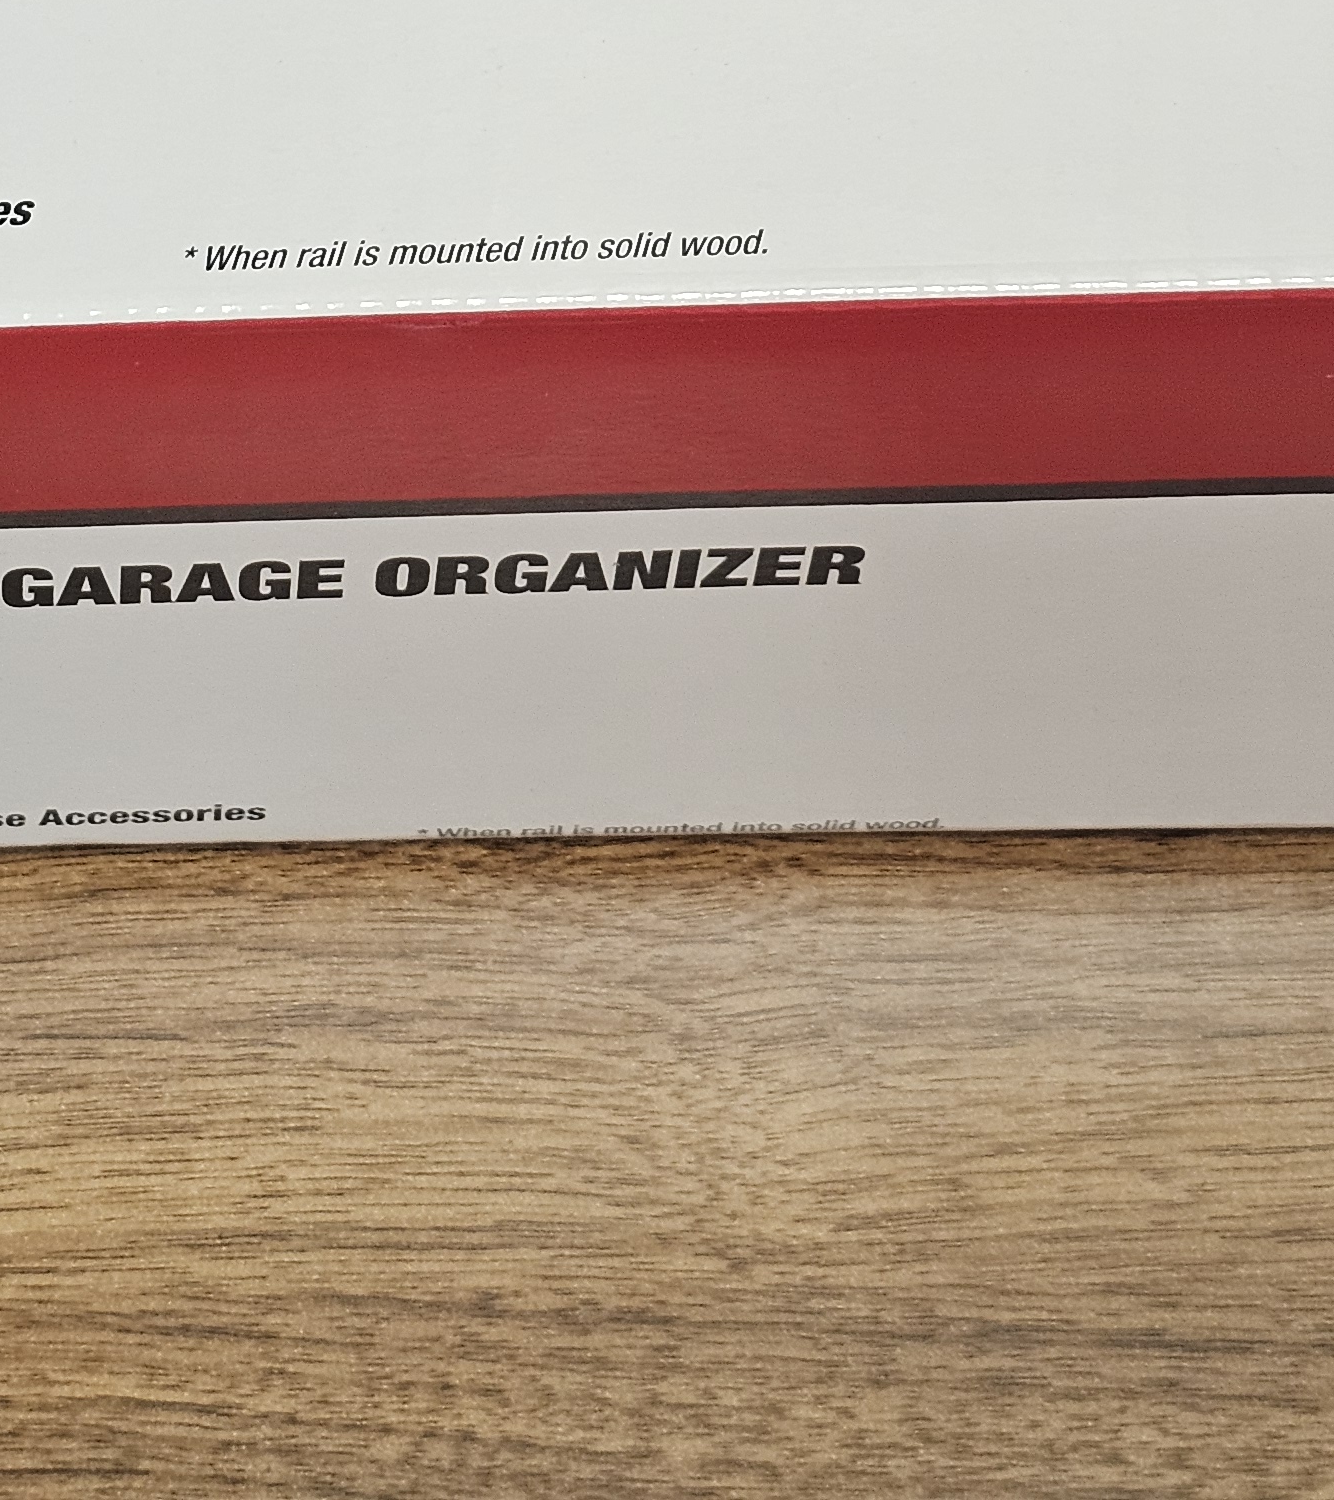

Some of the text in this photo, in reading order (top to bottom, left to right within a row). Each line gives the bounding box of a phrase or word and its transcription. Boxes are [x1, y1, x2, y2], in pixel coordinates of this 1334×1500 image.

[206, 245, 287, 271] When
[296, 241, 347, 268] rail
[354, 240, 380, 266] is
[389, 236, 524, 265] mounted
[531, 235, 588, 261] into
[598, 232, 671, 259] solid
[682, 229, 767, 256] wood.
[2, 559, 345, 607] GARAGE
[375, 546, 865, 597] ORGANIZER
[39, 804, 265, 826] Accessories
[437, 826, 513, 838] When
[520, 824, 565, 836] rail
[571, 823, 595, 835] is
[604, 820, 725, 834] mounted
[731, 818, 783, 832] into
[791, 817, 856, 831] solid
[864, 816, 946, 829] wood.
